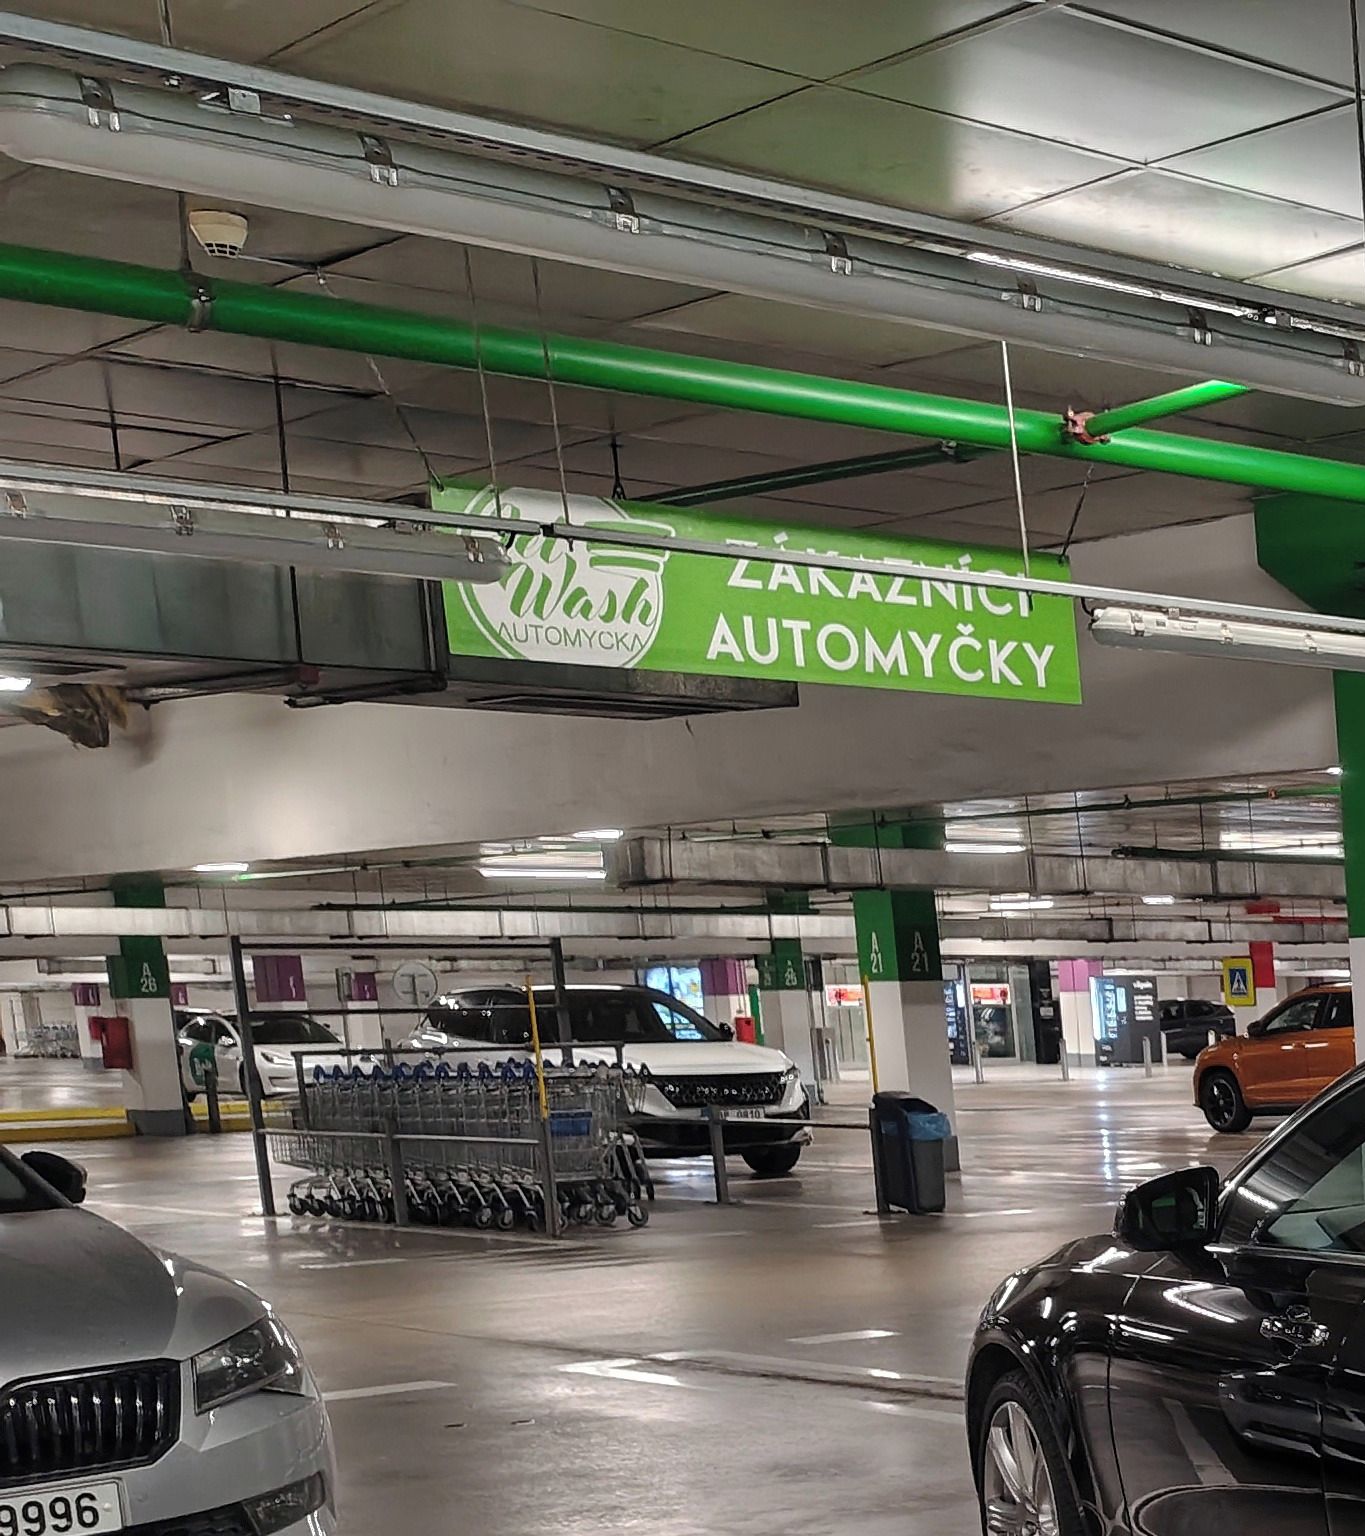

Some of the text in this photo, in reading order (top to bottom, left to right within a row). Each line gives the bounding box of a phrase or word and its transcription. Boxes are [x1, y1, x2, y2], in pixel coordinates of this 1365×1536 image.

[500, 553, 656, 627] Wash
[706, 613, 1054, 688] AUTOMYČKY
[871, 931, 879, 953] A
[914, 931, 924, 951] A
[143, 962, 151, 976] A
[870, 952, 883, 973] 21
[911, 951, 929, 972] 21
